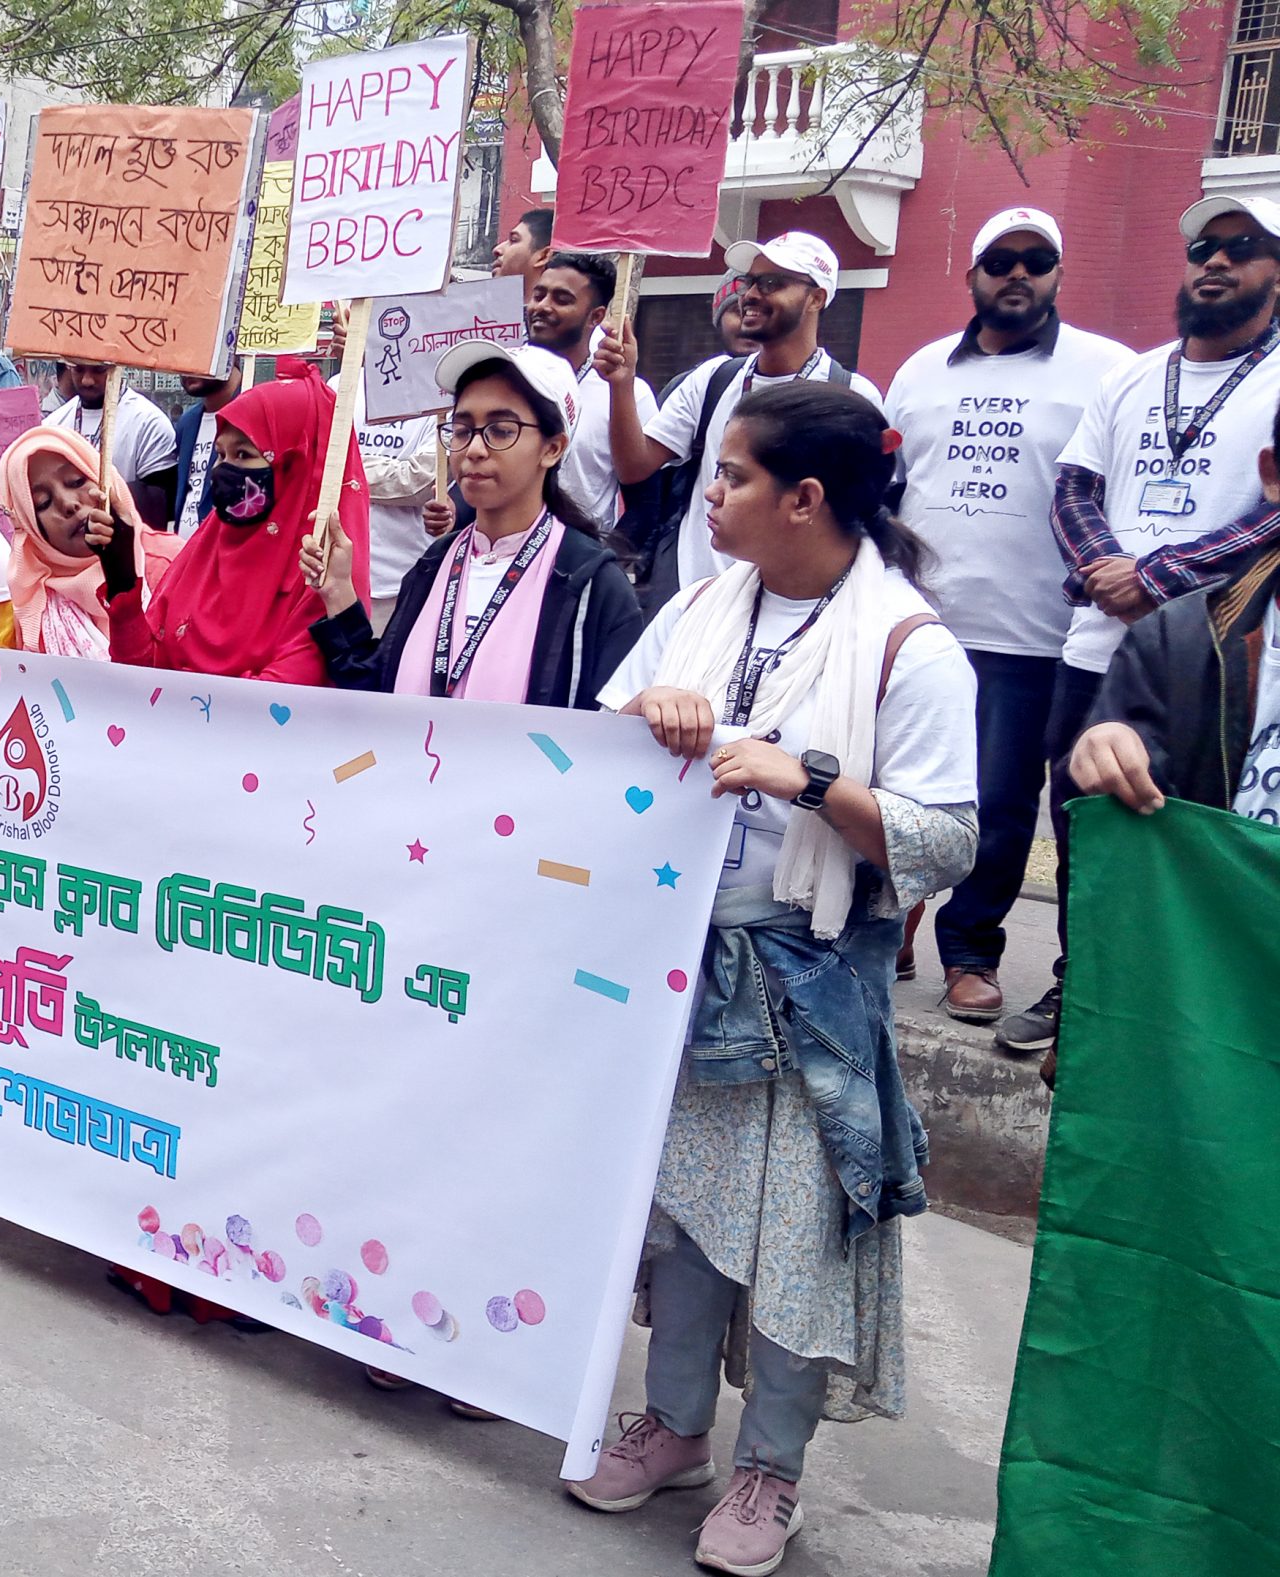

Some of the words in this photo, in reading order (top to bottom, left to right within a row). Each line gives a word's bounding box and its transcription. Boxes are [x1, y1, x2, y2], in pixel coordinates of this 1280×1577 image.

[586, 26, 718, 87] HAPPY
[307, 56, 458, 130] HAPPY
[580, 104, 729, 151] BIRTHDAY
[42, 131, 120, 177] দালাল
[185, 138, 243, 177] রক্ত
[300, 131, 462, 203] BIRTHDAY
[156, 197, 239, 252] কঠোর
[306, 208, 424, 270] BBDC
[29, 246, 104, 296] আইন
[28, 305, 110, 342] করতে
[383, 316, 406, 328] STOP
[957, 396, 1031, 415] EVERY
[358, 431, 405, 450] BLOOD
[951, 420, 1025, 438] BLOOD
[946, 444, 1020, 464] DONOR
[950, 481, 1008, 501] HERO
[514, 545, 537, 570] Barishal
[528, 531, 547, 551] Blood
[451, 653, 470, 681] Barishal
[464, 638, 478, 659] Blood
[471, 619, 489, 643] Donors
[482, 607, 497, 625] Club
[491, 586, 510, 606] BBDC
[745, 665, 761, 691] Donors
[741, 690, 754, 708] Club
[29, 703, 50, 739] Club
[735, 711, 748, 728] BB
[44, 738, 61, 798] Donors
[31, 799, 60, 839] Blood
[54, 861, 143, 937] ক্লাব
[155, 872, 386, 1004] (বিবিডিসি)
[404, 963, 471, 1024] এর
